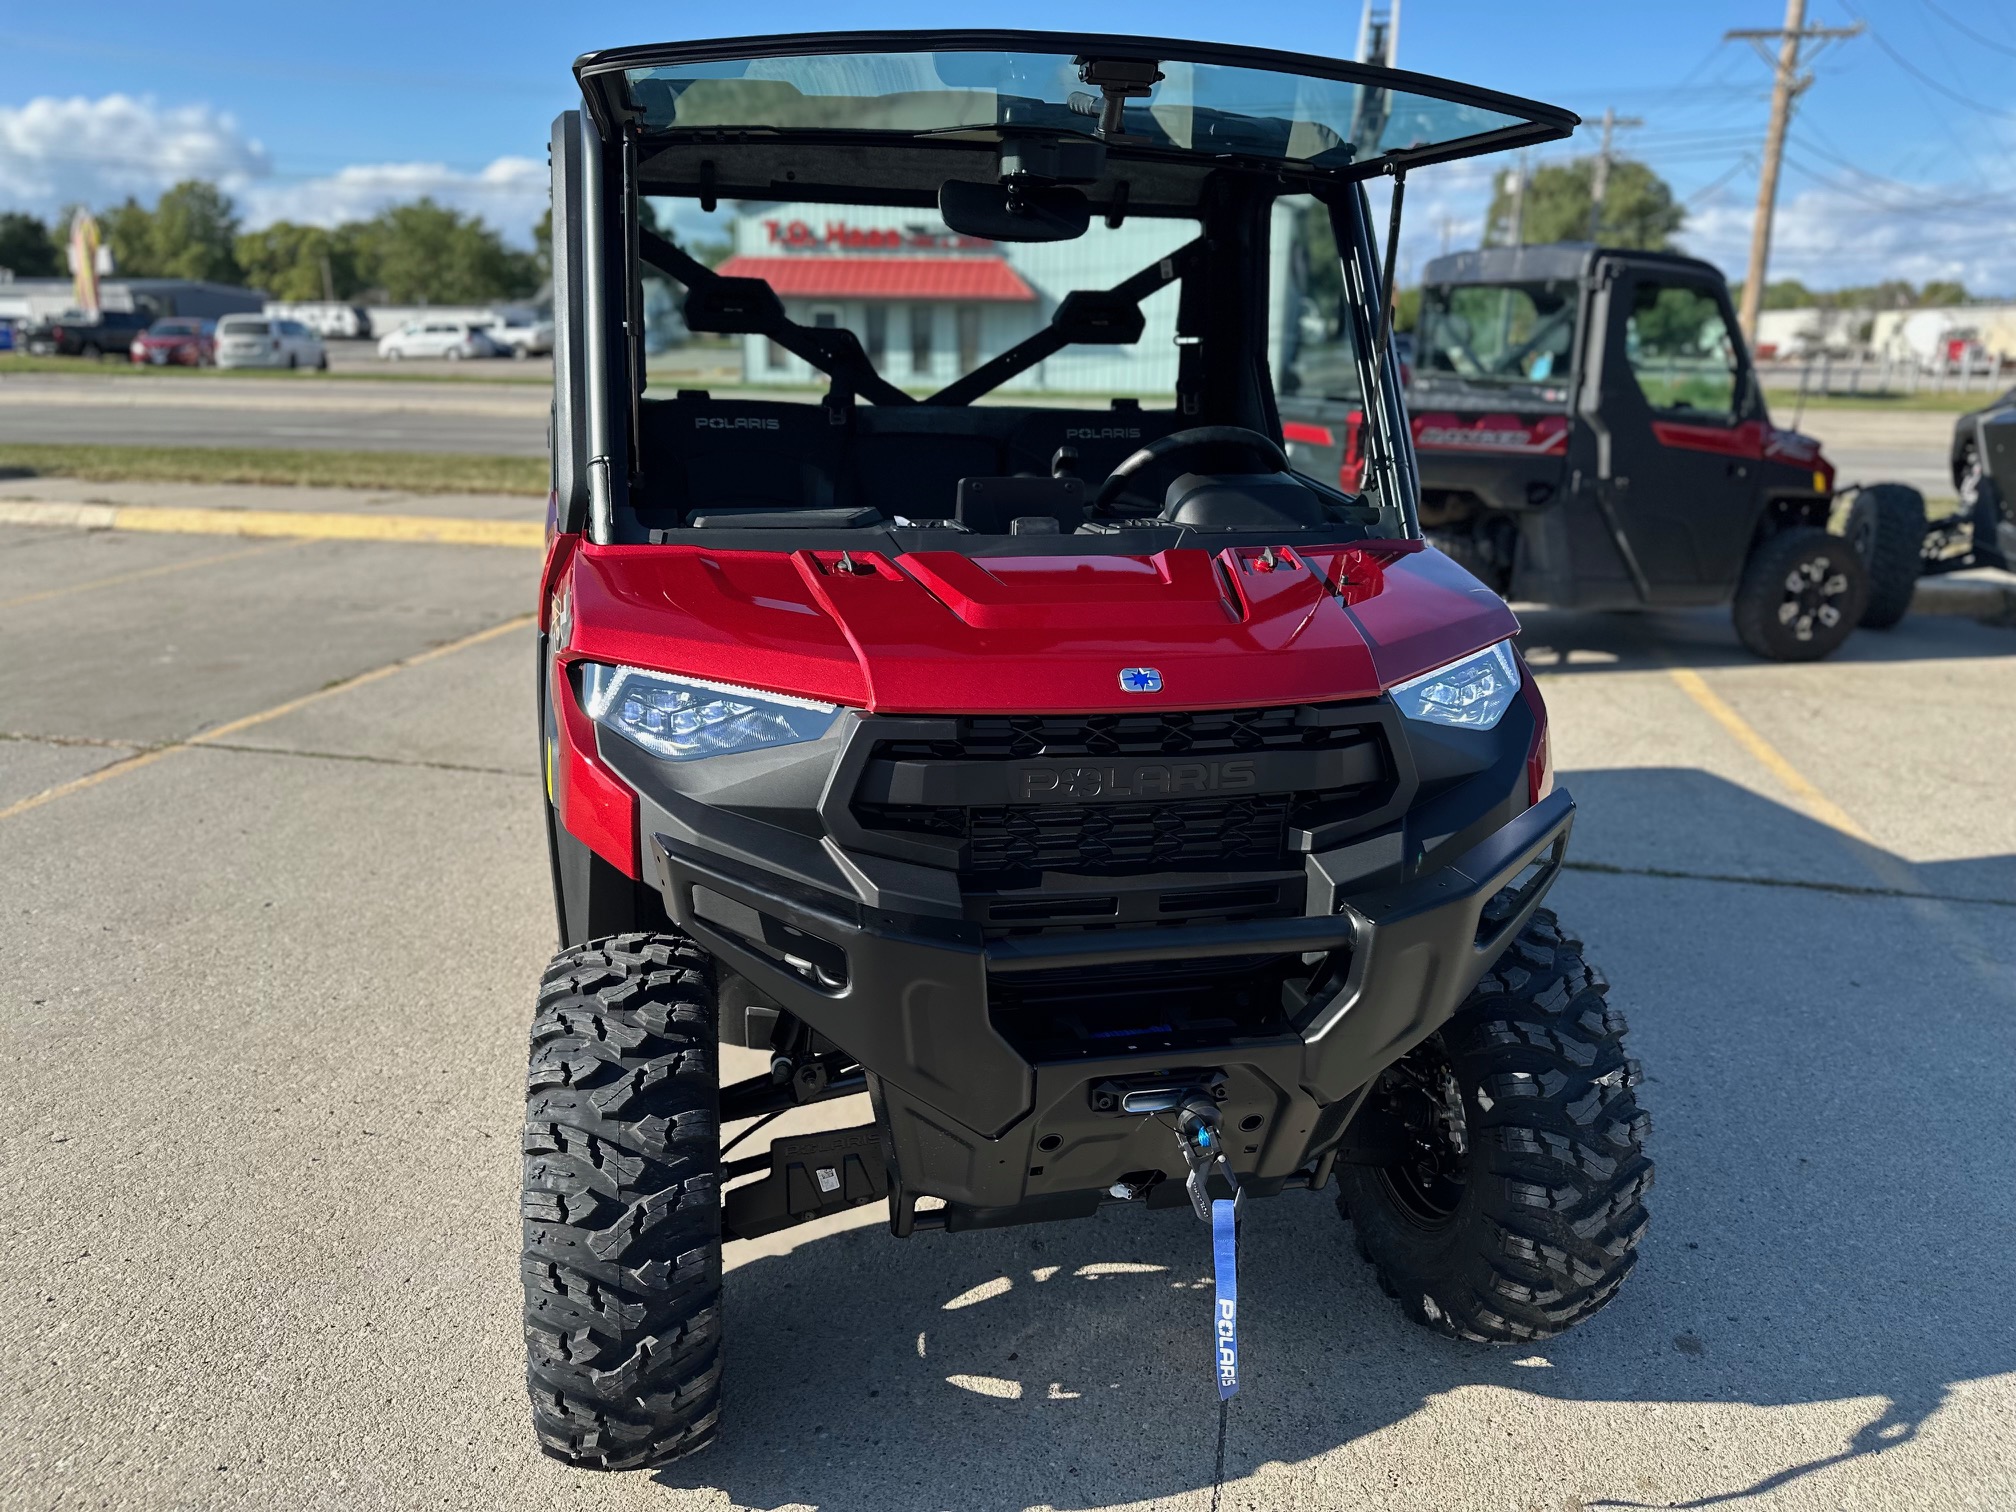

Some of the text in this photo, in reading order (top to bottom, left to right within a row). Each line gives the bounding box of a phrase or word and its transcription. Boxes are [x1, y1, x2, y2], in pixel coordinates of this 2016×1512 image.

[695, 417, 779, 430] POLARIS
[1066, 428, 1141, 439] POLARIS
[1019, 760, 1256, 799] POLARIS
[785, 1133, 882, 1157] POLARIS
[1218, 1298, 1236, 1387] POLARIS
